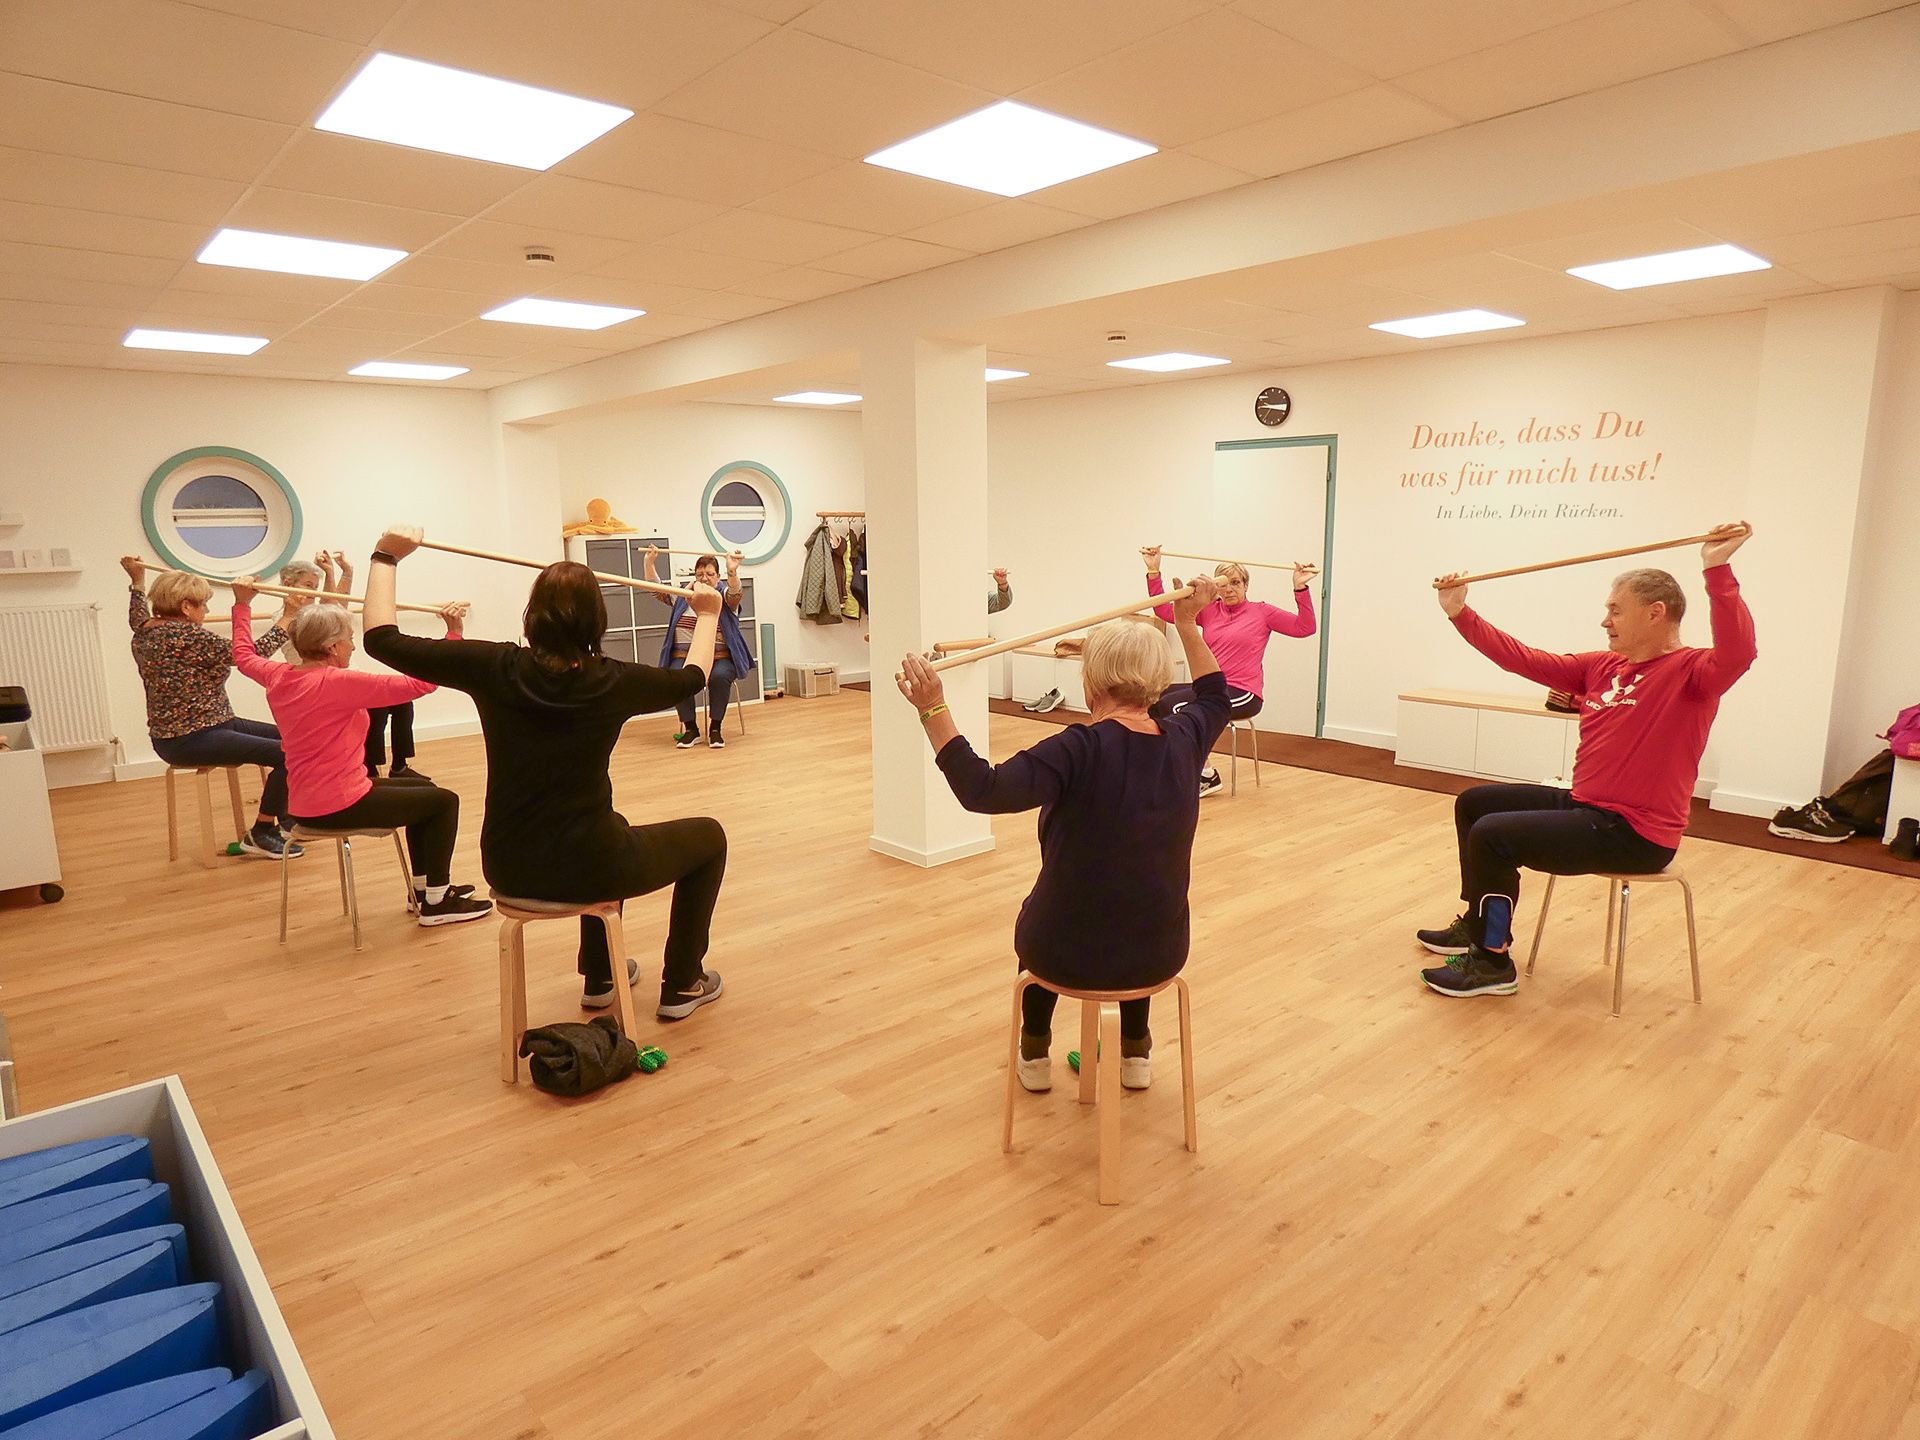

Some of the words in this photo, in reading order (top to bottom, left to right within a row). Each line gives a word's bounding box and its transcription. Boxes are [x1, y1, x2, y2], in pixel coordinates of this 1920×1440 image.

[1409, 421, 1505, 450] Danke,
[1517, 416, 1581, 444] dass
[1592, 411, 1645, 440] Du
[1400, 471, 1448, 488] was
[1450, 461, 1498, 495] für
[1507, 457, 1578, 486] mich
[1588, 452, 1663, 482] tust!
[1436, 504, 1453, 520] In
[1509, 503, 1548, 520] Dein
[1555, 502, 1624, 520] Rücken.
